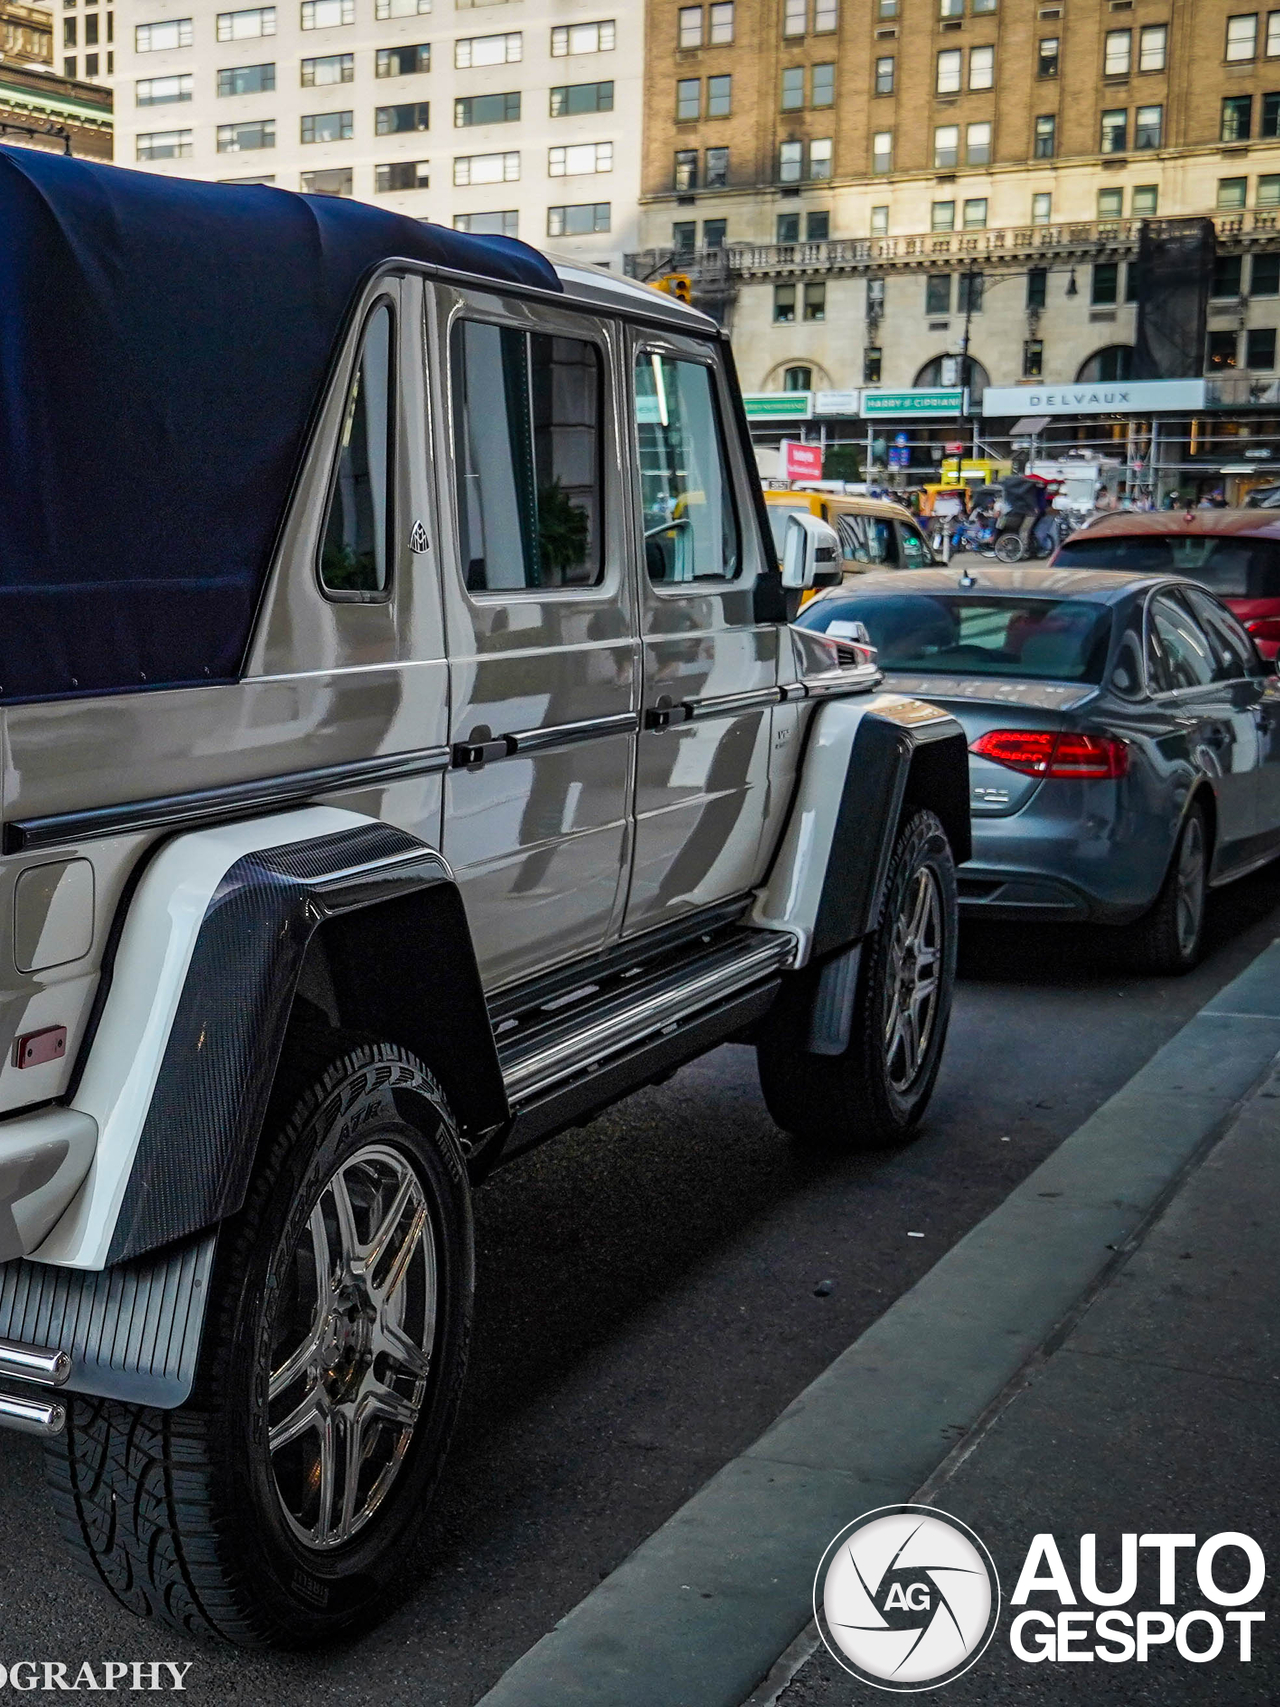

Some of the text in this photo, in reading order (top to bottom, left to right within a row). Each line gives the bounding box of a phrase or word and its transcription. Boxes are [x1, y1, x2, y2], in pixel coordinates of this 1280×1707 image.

[867, 399, 902, 408] HARRY
[914, 397, 960, 408] CIPRIANI
[1029, 391, 1130, 407] DELVAUX
